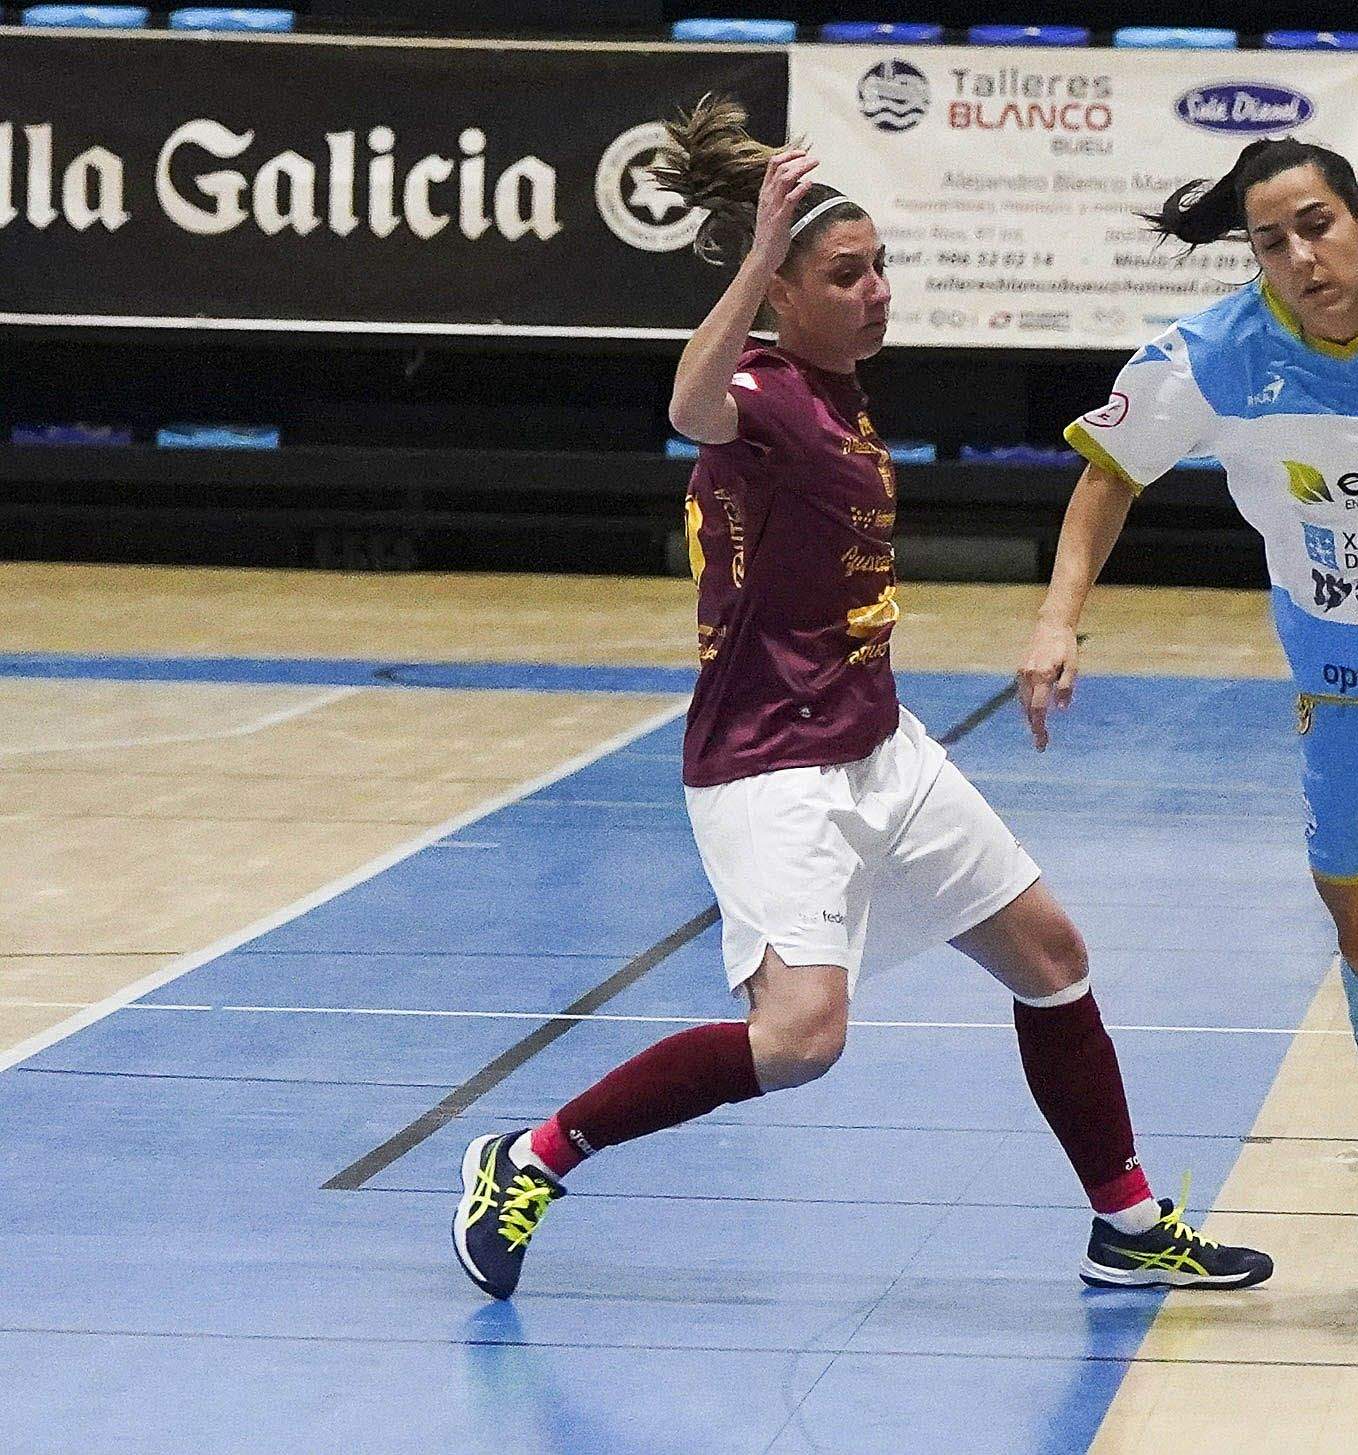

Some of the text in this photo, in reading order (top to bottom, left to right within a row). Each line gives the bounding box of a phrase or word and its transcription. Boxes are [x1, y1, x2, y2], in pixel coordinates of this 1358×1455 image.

[949, 65, 1113, 98] Talleres
[949, 101, 1113, 131] BLANCO
[1050, 135, 1114, 156] BUEU
[155, 118, 563, 241] Galicia
